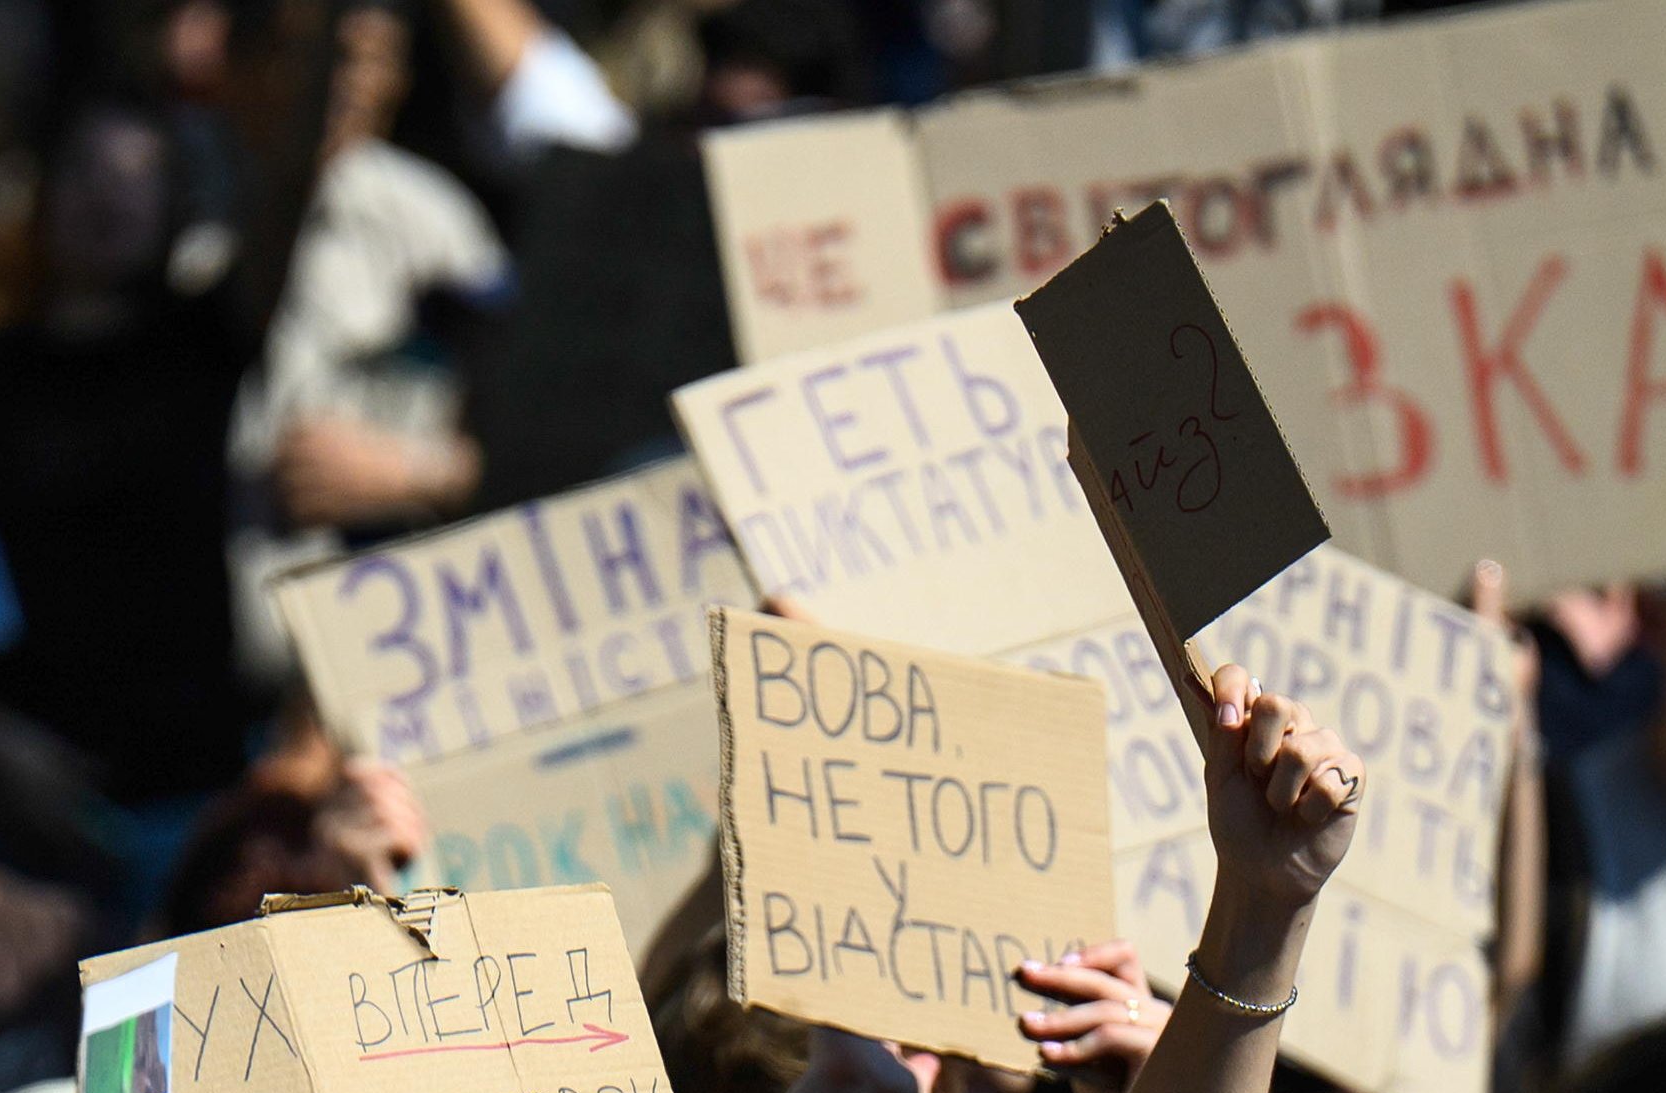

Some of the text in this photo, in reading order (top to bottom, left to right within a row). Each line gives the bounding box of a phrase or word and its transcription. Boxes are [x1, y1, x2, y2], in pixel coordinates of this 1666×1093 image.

[719, 332, 1023, 500] ГЕТЬ
[337, 476, 737, 712] ЗМІНА
[1233, 558, 1515, 722] РНІТЬ
[1213, 608, 1501, 812] ОРОВА
[759, 748, 873, 844] НЕ
[879, 766, 1059, 874] ТОГО
[761, 888, 1095, 1020] ВІДСТАВ
[871, 852, 909, 936] У
[173, 946, 615, 1084] УХ ВПЕРЕД
